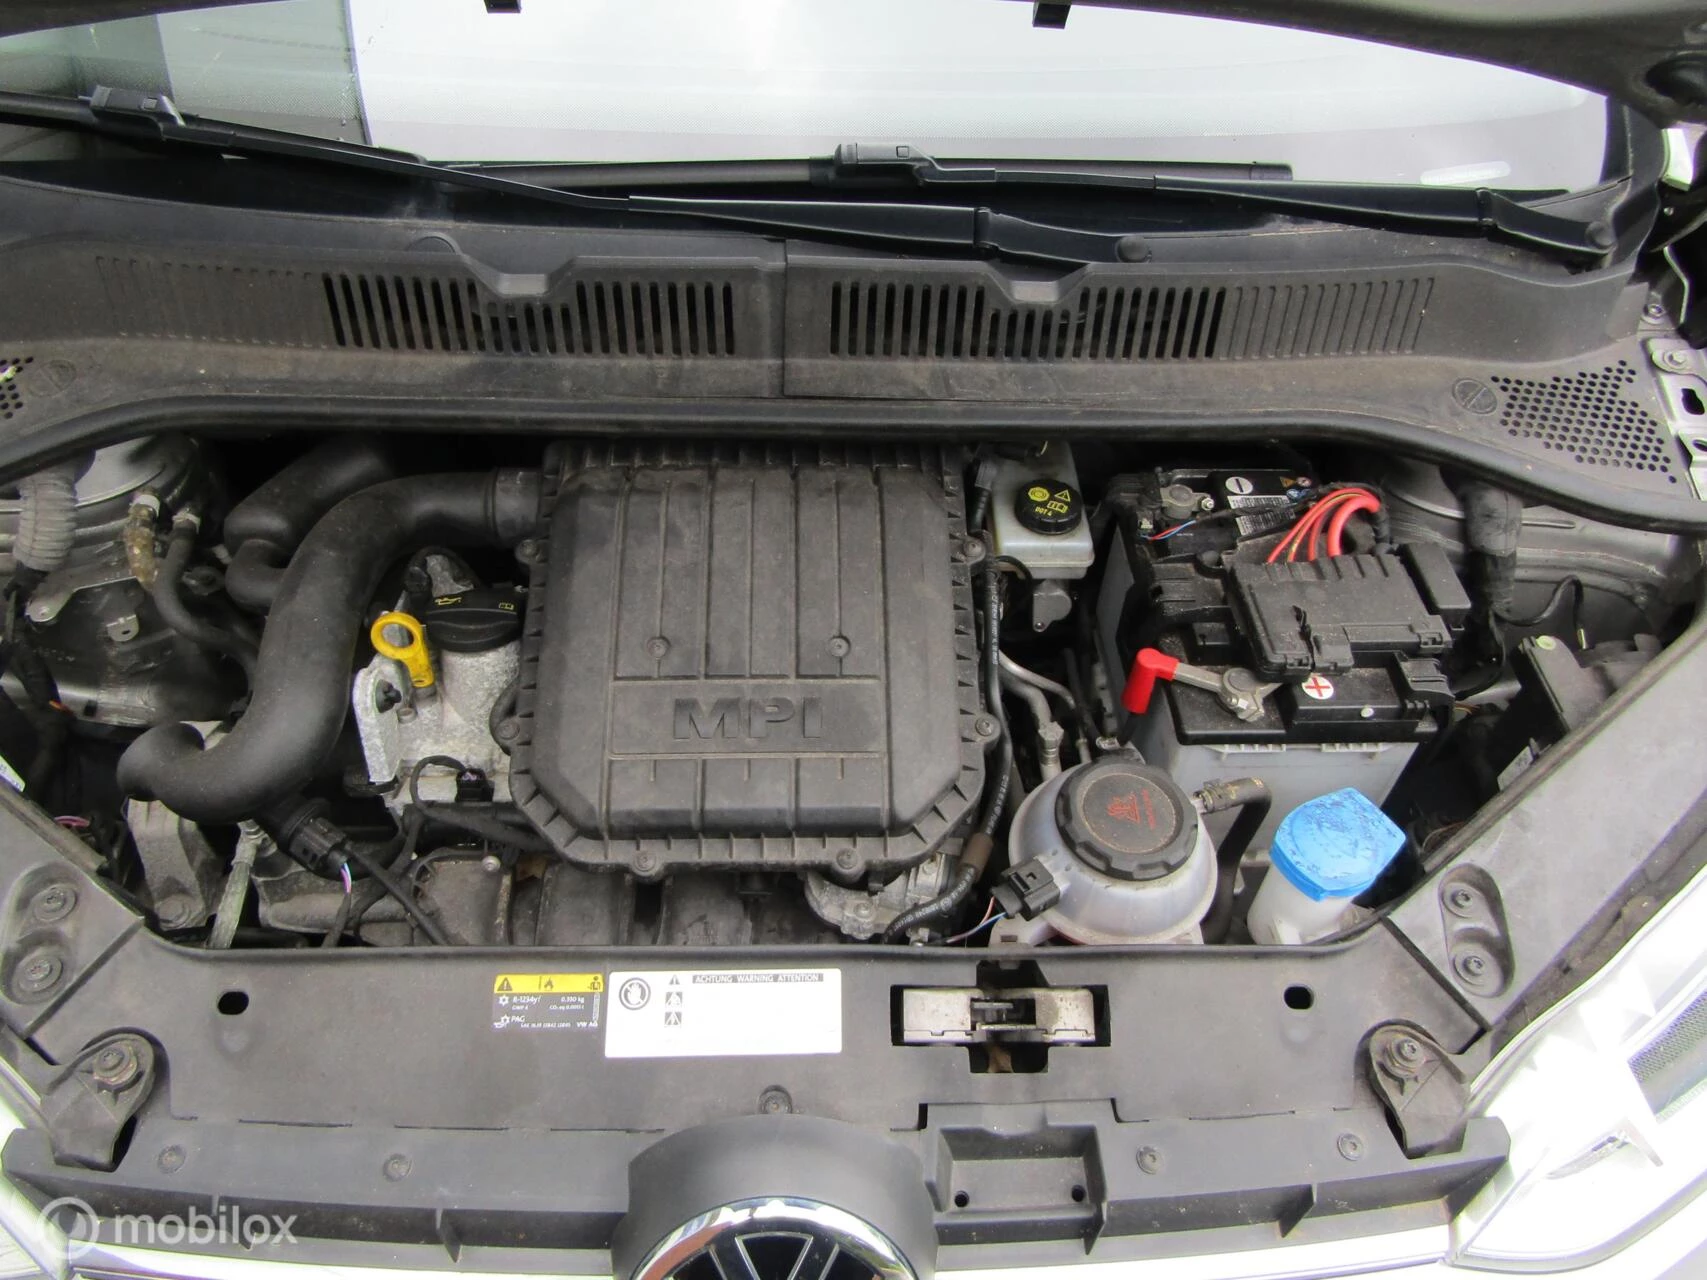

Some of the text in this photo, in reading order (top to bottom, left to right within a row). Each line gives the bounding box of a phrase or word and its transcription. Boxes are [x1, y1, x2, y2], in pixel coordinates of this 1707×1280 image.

[673, 697, 822, 739] MPI
[695, 973, 819, 984] ACHTUNG WARNING ATTENTION
[511, 1015, 526, 1023] PAG
